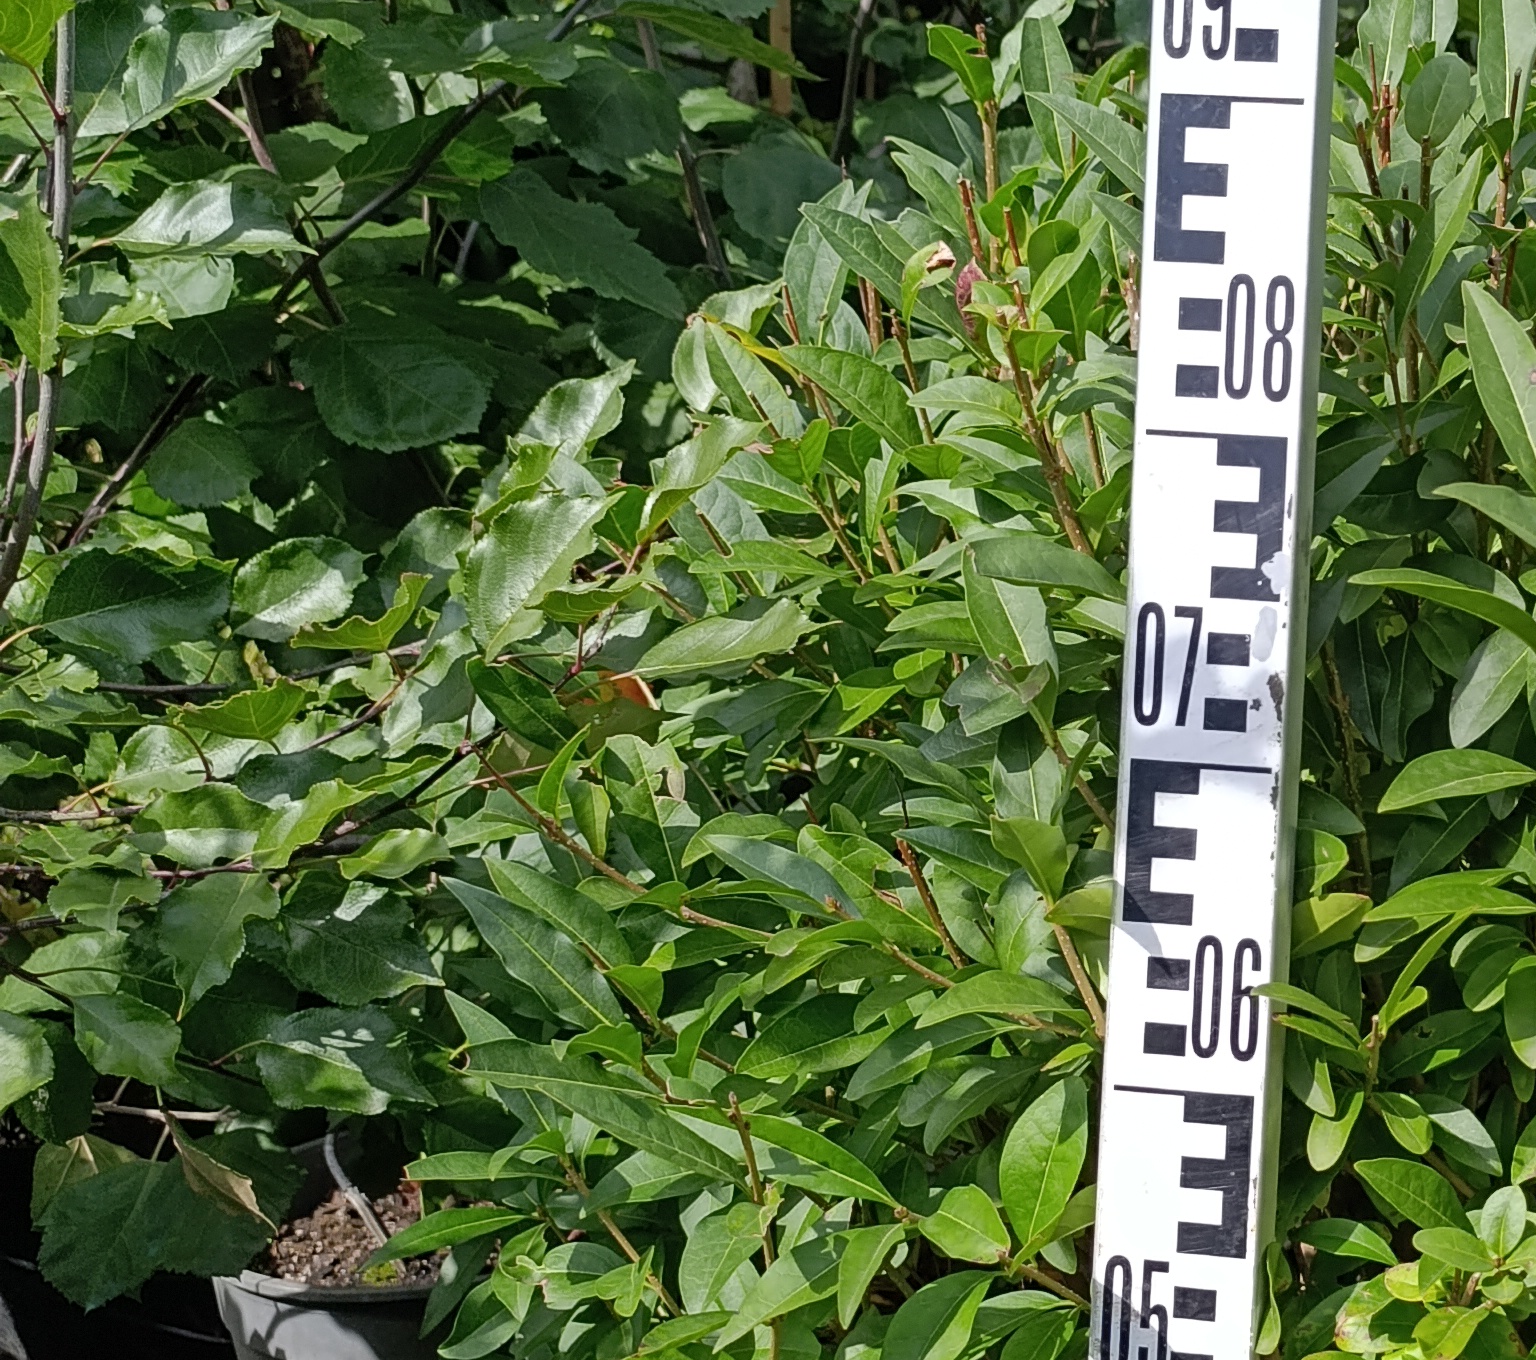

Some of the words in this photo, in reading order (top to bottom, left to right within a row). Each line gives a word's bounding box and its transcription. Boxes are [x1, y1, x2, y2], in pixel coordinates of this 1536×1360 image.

[1223, 273, 1295, 402] 08
[1133, 601, 1204, 727] 07
[1191, 934, 1262, 1062] 06
